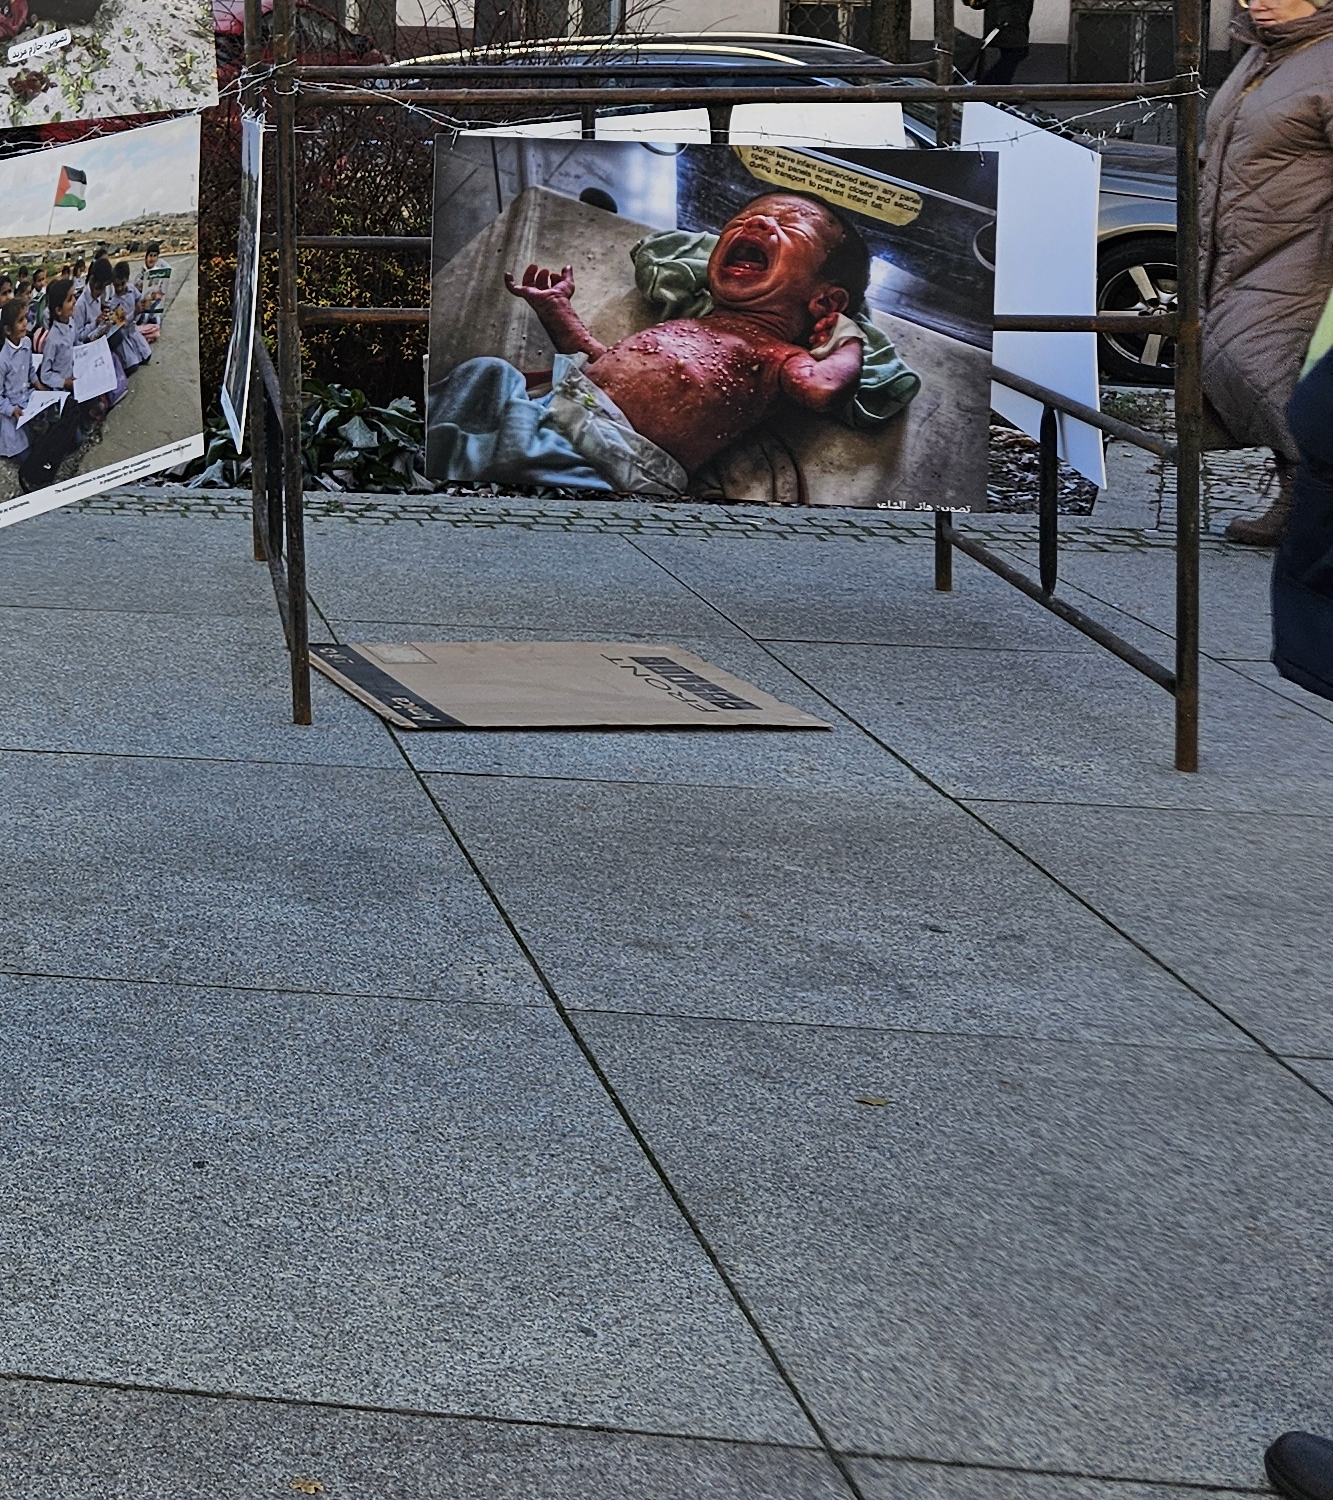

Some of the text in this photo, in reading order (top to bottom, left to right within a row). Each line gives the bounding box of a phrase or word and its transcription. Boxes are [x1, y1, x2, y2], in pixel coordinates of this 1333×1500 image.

[749, 160, 772, 174] during
[775, 168, 806, 184] transport
[809, 179, 817, 188] to
[817, 182, 844, 198] prevent
[847, 192, 868, 206] infant
[751, 145, 763, 153] Do
[763, 147, 776, 158] not
[777, 151, 795, 164] leave
[797, 157, 817, 171] infant
[818, 164, 858, 184] unattended
[859, 178, 879, 192] when
[882, 187, 897, 199] any
[751, 152, 771, 164] open.
[775, 160, 785, 169] All
[788, 164, 811, 178] panels
[815, 174, 833, 185] must
[836, 179, 846, 189] be
[848, 183, 874, 198] closed
[876, 192, 891, 204] and
[600, 653, 719, 713] FRONT
